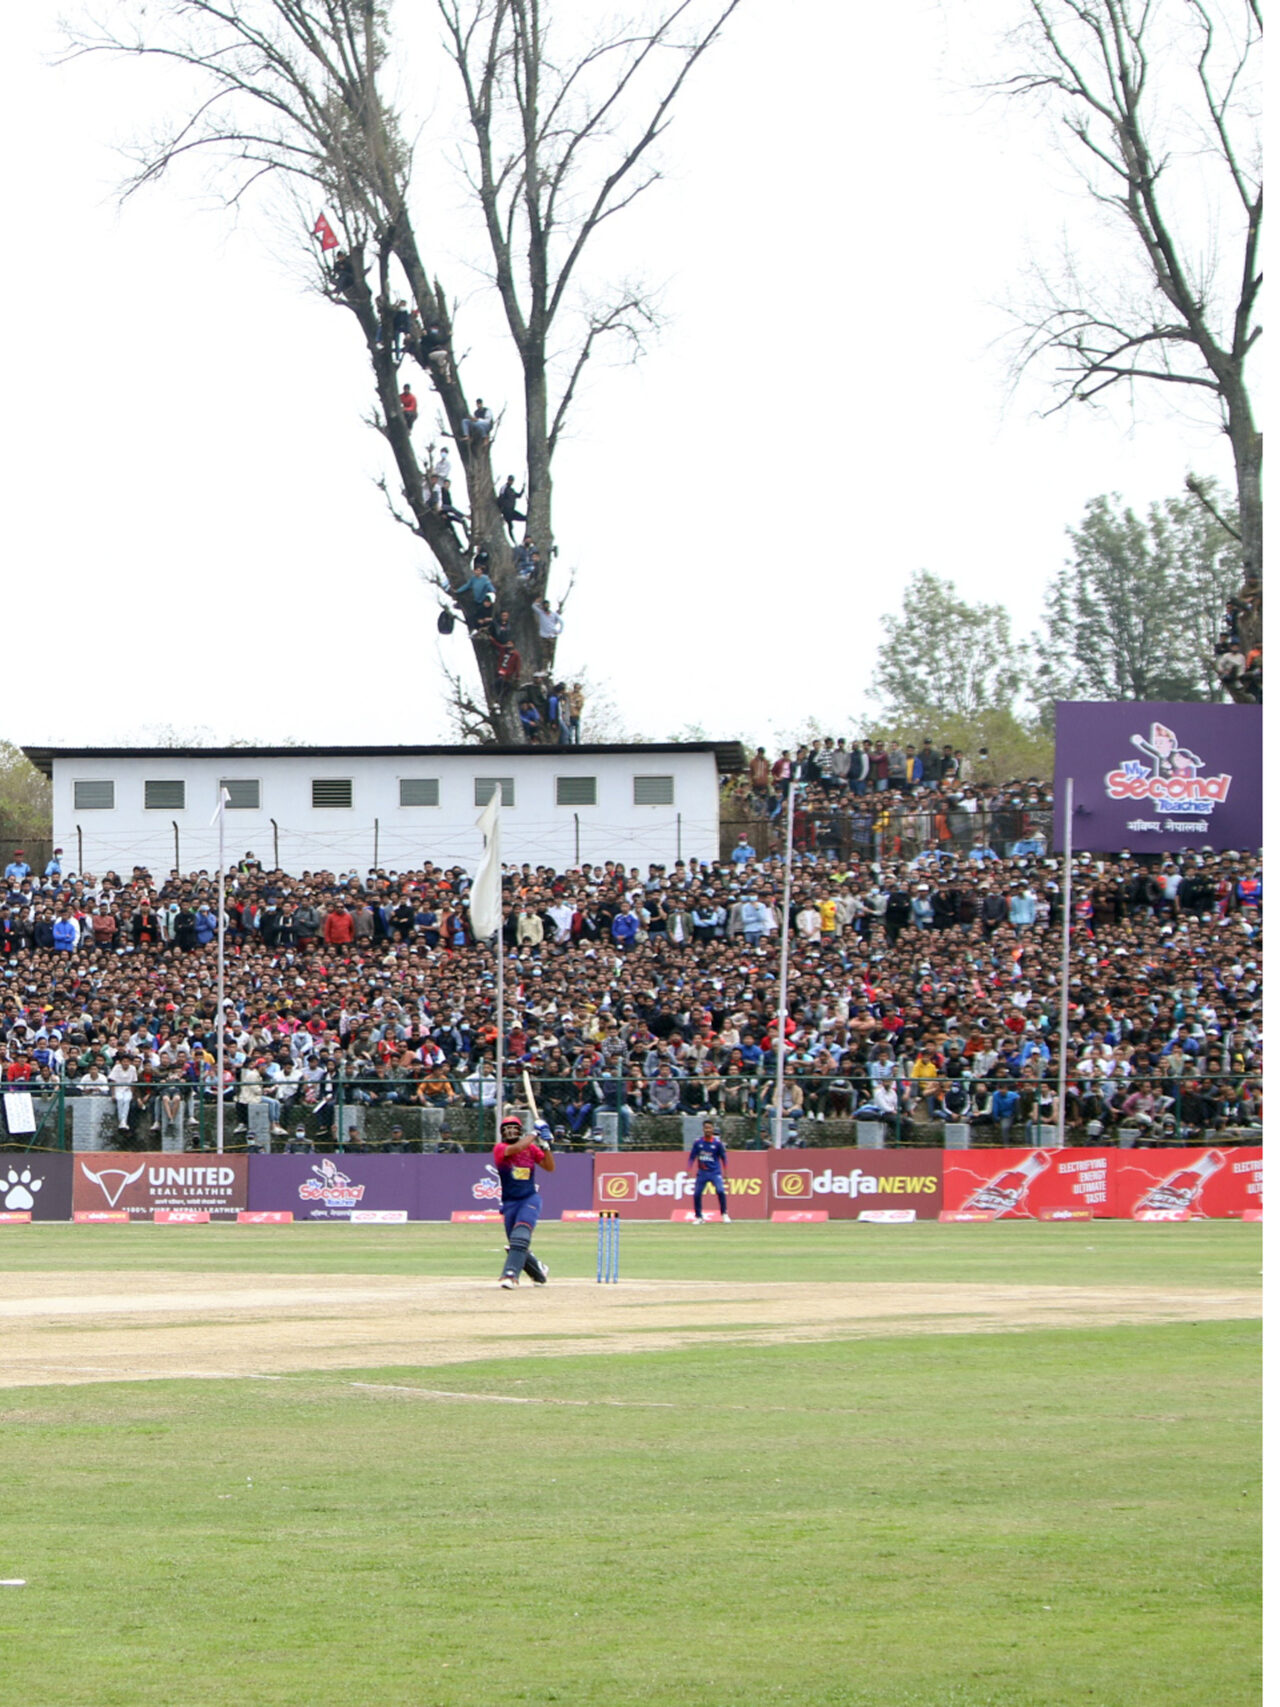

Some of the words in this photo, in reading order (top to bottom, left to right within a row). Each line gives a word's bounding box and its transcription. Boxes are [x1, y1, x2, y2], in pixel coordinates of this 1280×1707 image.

[1124, 762, 1148, 780] My
[1108, 772, 1231, 801] Second
[1159, 800, 1213, 812] Teacher
[1057, 1158, 1107, 1174] ELECTRIFYING
[149, 1167, 235, 1186] UNITED
[813, 1169, 938, 1198] dafaNEWS
[150, 1188, 178, 1196] REAL
[183, 1188, 233, 1196] LEATHER
[299, 1185, 365, 1200] Second
[1085, 1192, 1107, 1204] TASTE
[168, 1213, 198, 1222] KFC
[1142, 1210, 1185, 1220] KFC
